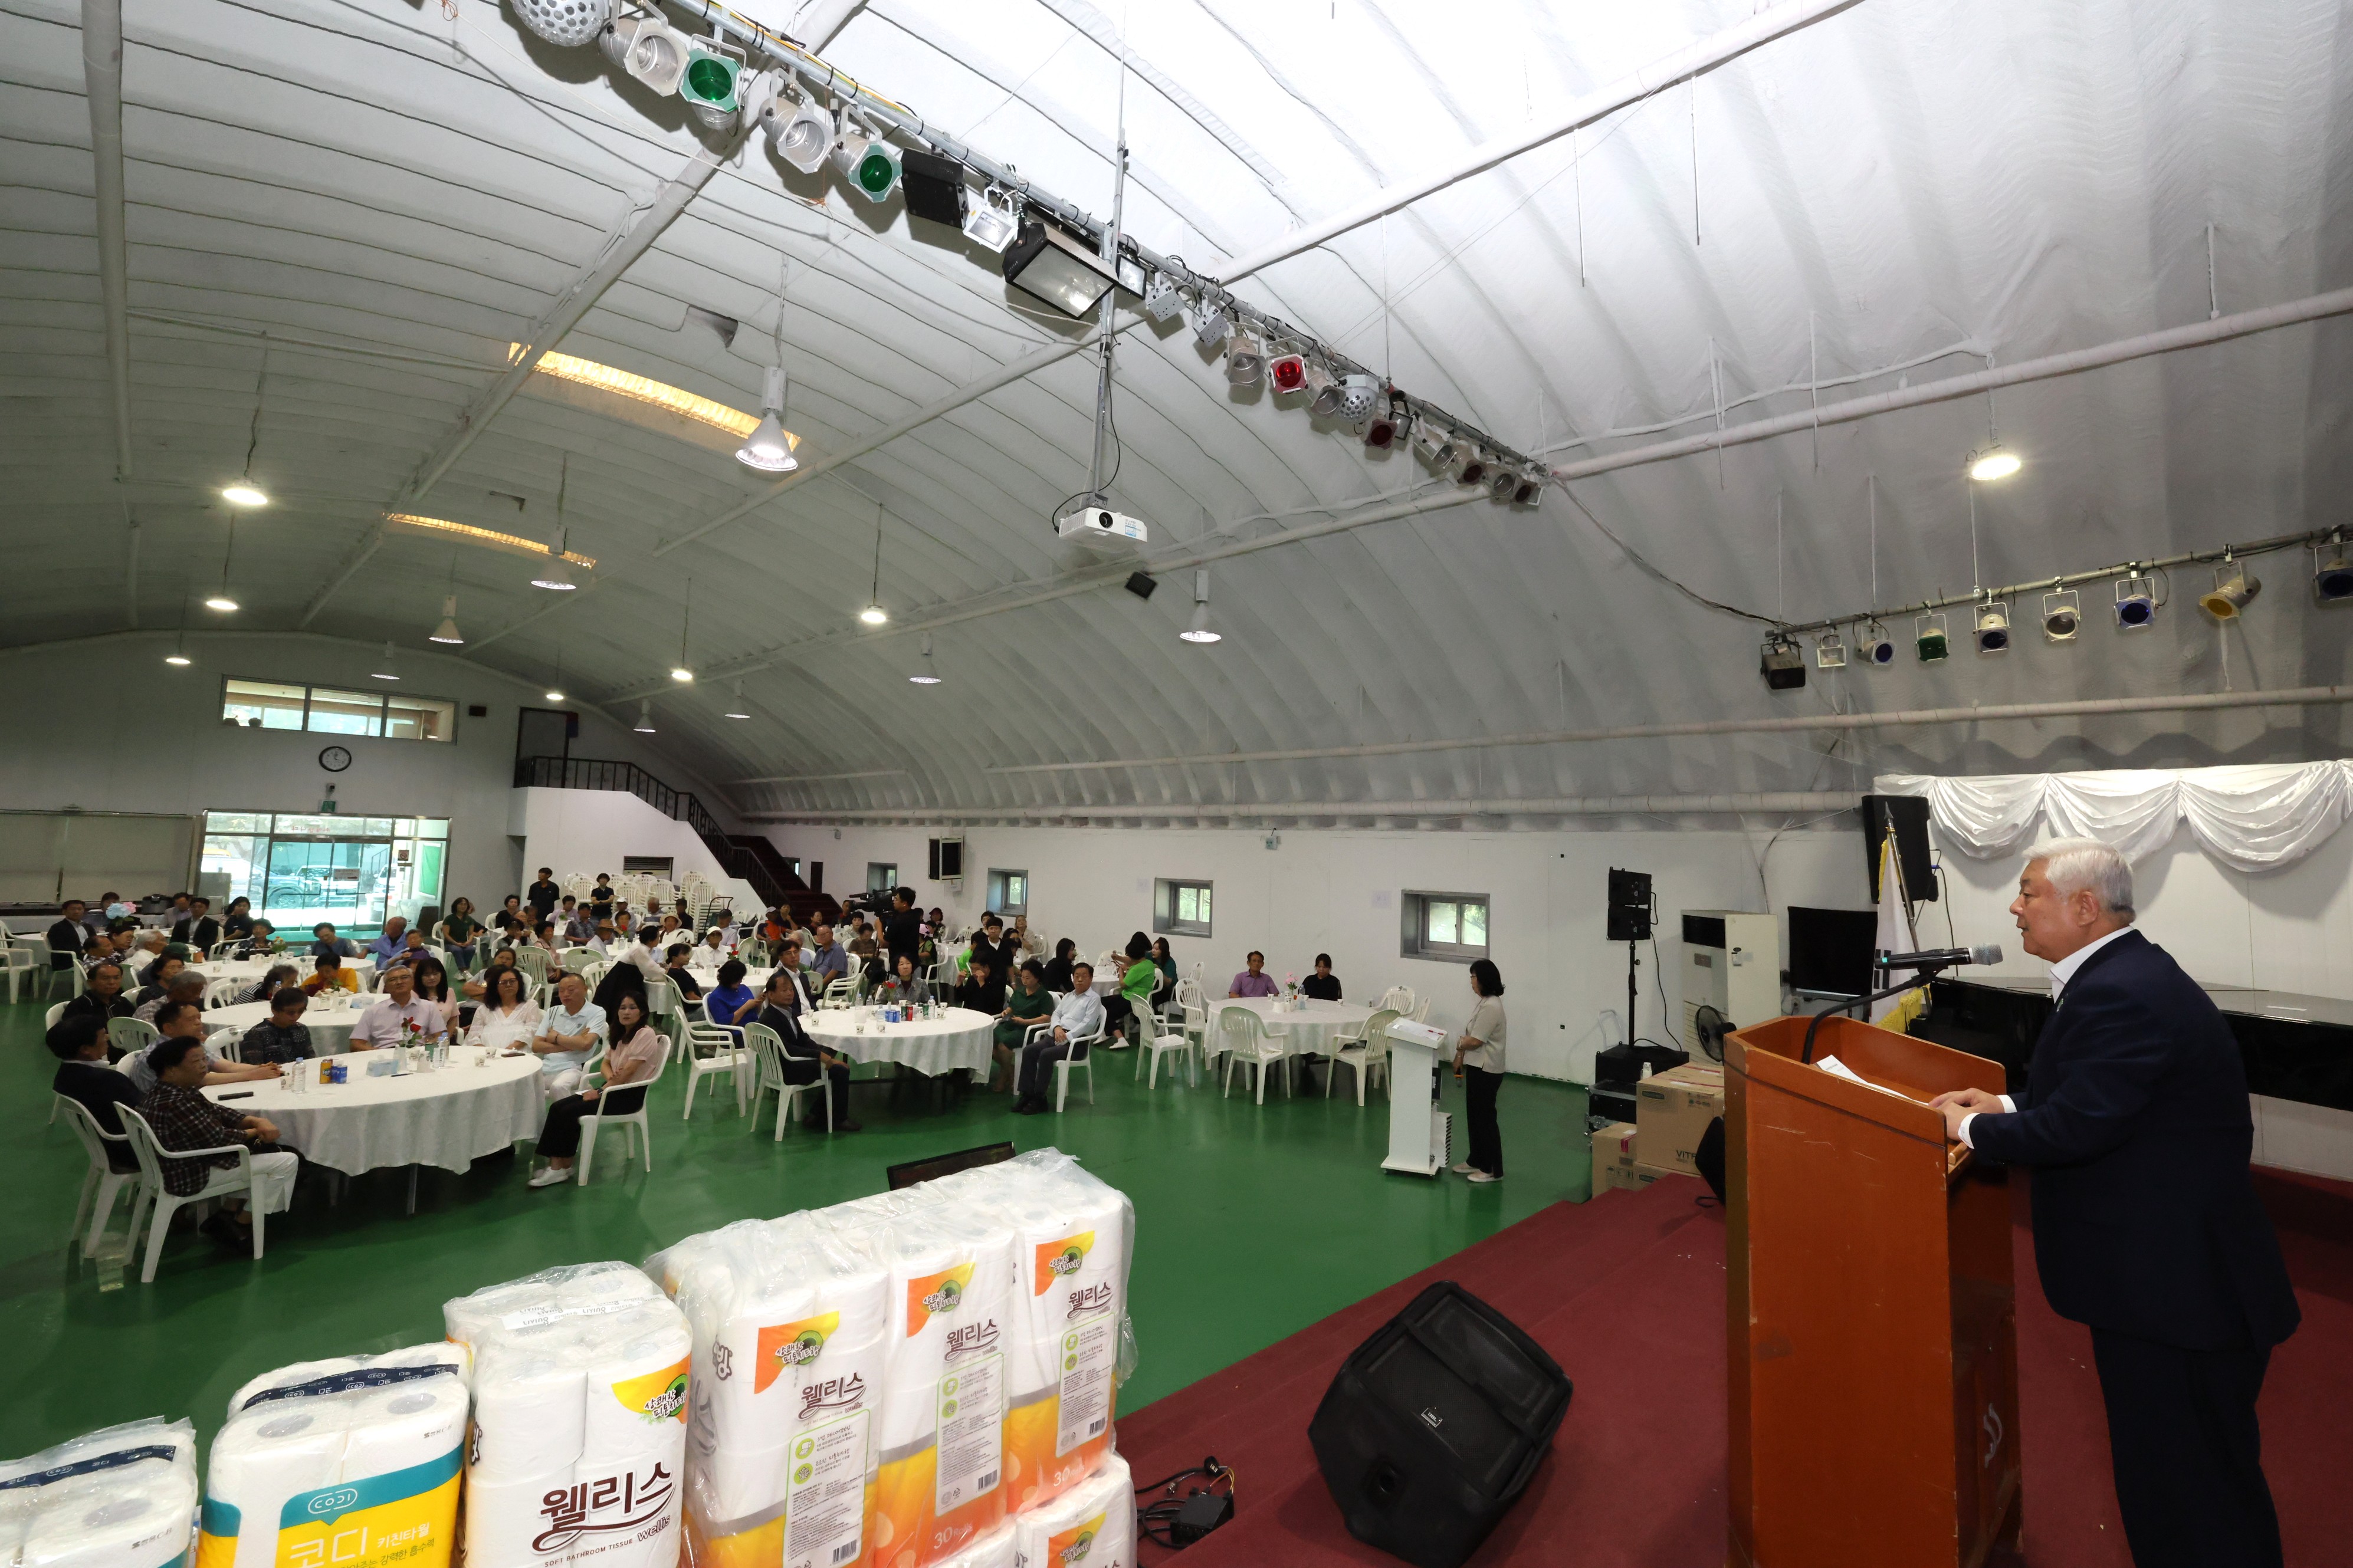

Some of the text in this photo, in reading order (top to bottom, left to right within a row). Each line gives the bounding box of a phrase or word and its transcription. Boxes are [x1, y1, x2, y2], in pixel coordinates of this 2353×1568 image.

[1068, 1281, 1112, 1315] 웰리스
[776, 1342, 804, 1356] 상쾌한
[946, 1319, 999, 1355] 웰리스
[783, 1345, 821, 1364] 피톤치드향
[645, 1389, 676, 1409] 상쾌한
[799, 1372, 865, 1414] 웰리스
[1054, 1467, 1070, 1487] 30
[537, 1461, 674, 1537] 웰리스
[289, 1522, 431, 1568] 코디 키친타월
[380, 1549, 408, 1566] 강력한
[409, 1537, 435, 1557] 흡수력
[544, 1515, 671, 1568] SOFT BATHROOM TISSUE wellis
[934, 1527, 953, 1550] 30
